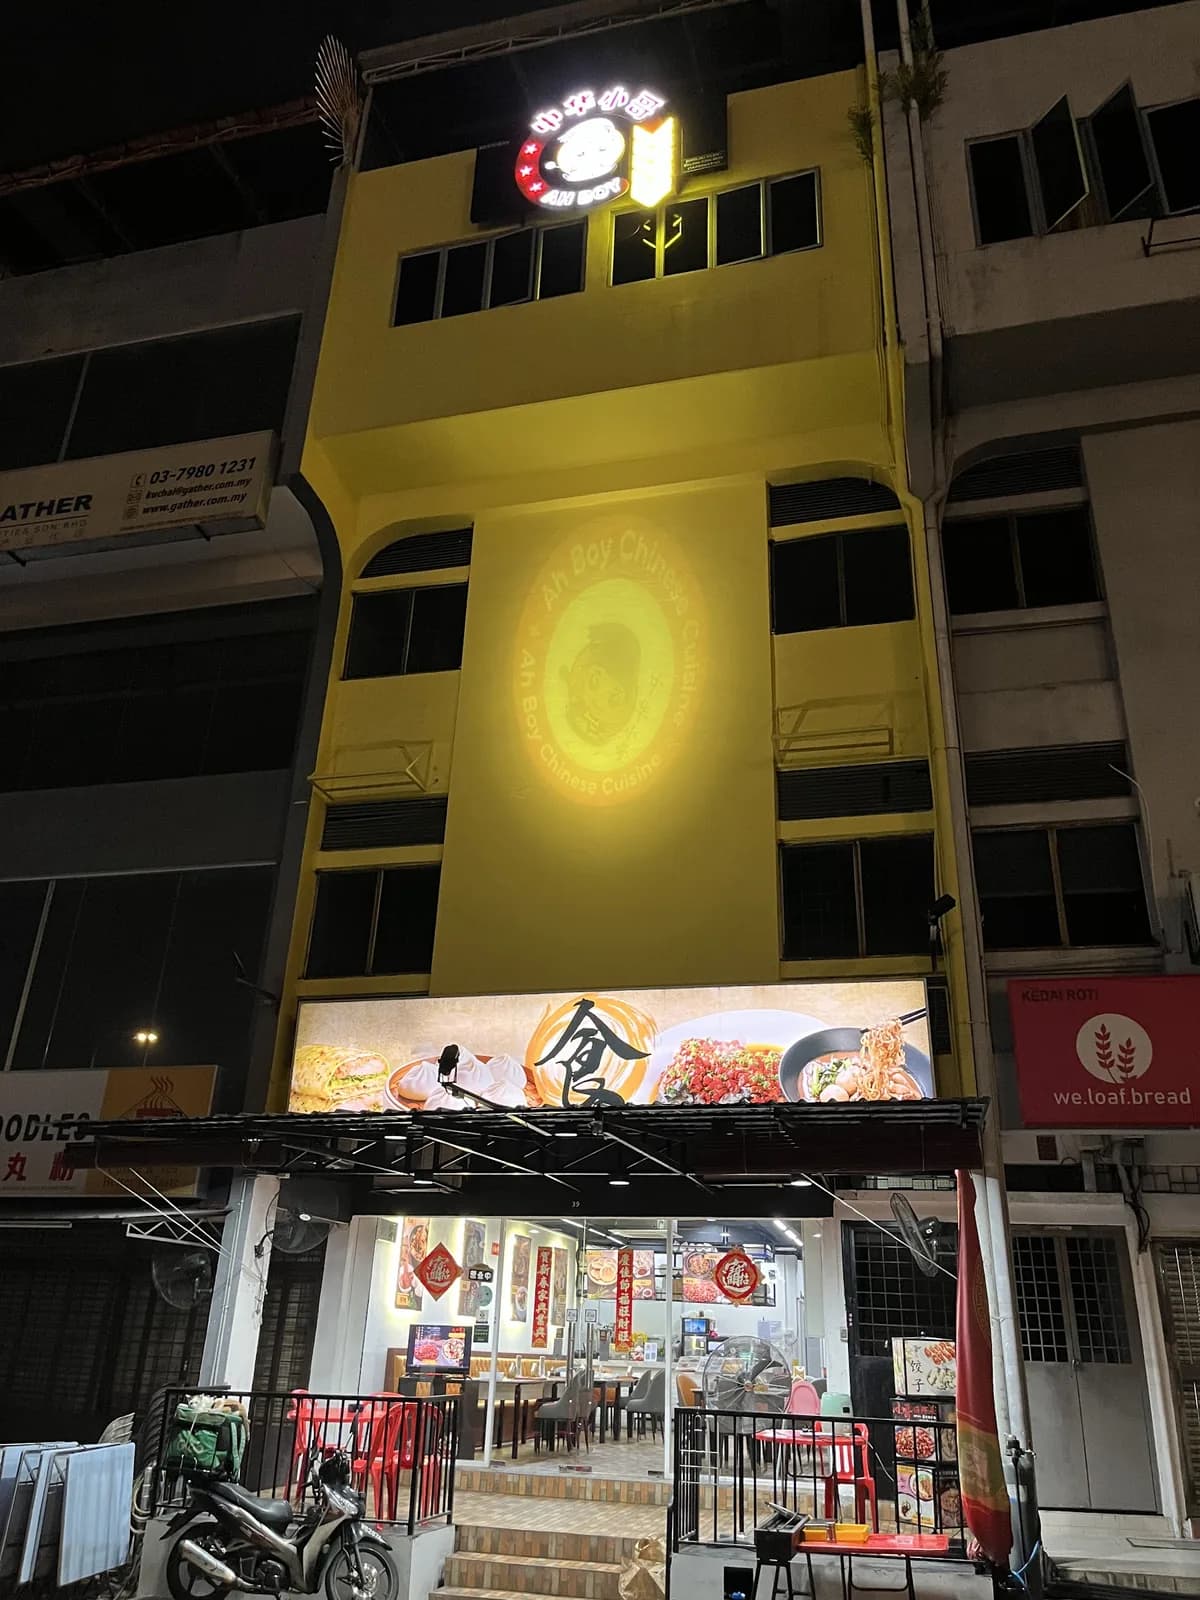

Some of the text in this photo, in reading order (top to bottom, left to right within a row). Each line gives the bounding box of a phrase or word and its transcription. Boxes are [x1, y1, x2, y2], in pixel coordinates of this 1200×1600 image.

[540, 177, 620, 206] AH BOY
[150, 457, 257, 485] 03-7980 1231
[145, 478, 252, 499] kuchai@gather.com.my
[142, 492, 248, 516] www.gather.com.my
[542, 529, 700, 728] Ah Boy Chinese Cuisine
[520, 648, 663, 796] Ah Boy Chinese Cuisine
[1021, 988, 1099, 1002] KEDAI ROTI
[535, 998, 652, 1106] 食
[1053, 1087, 1192, 1105] we.loaf.bread
[0, 1113, 90, 1142] ODLES
